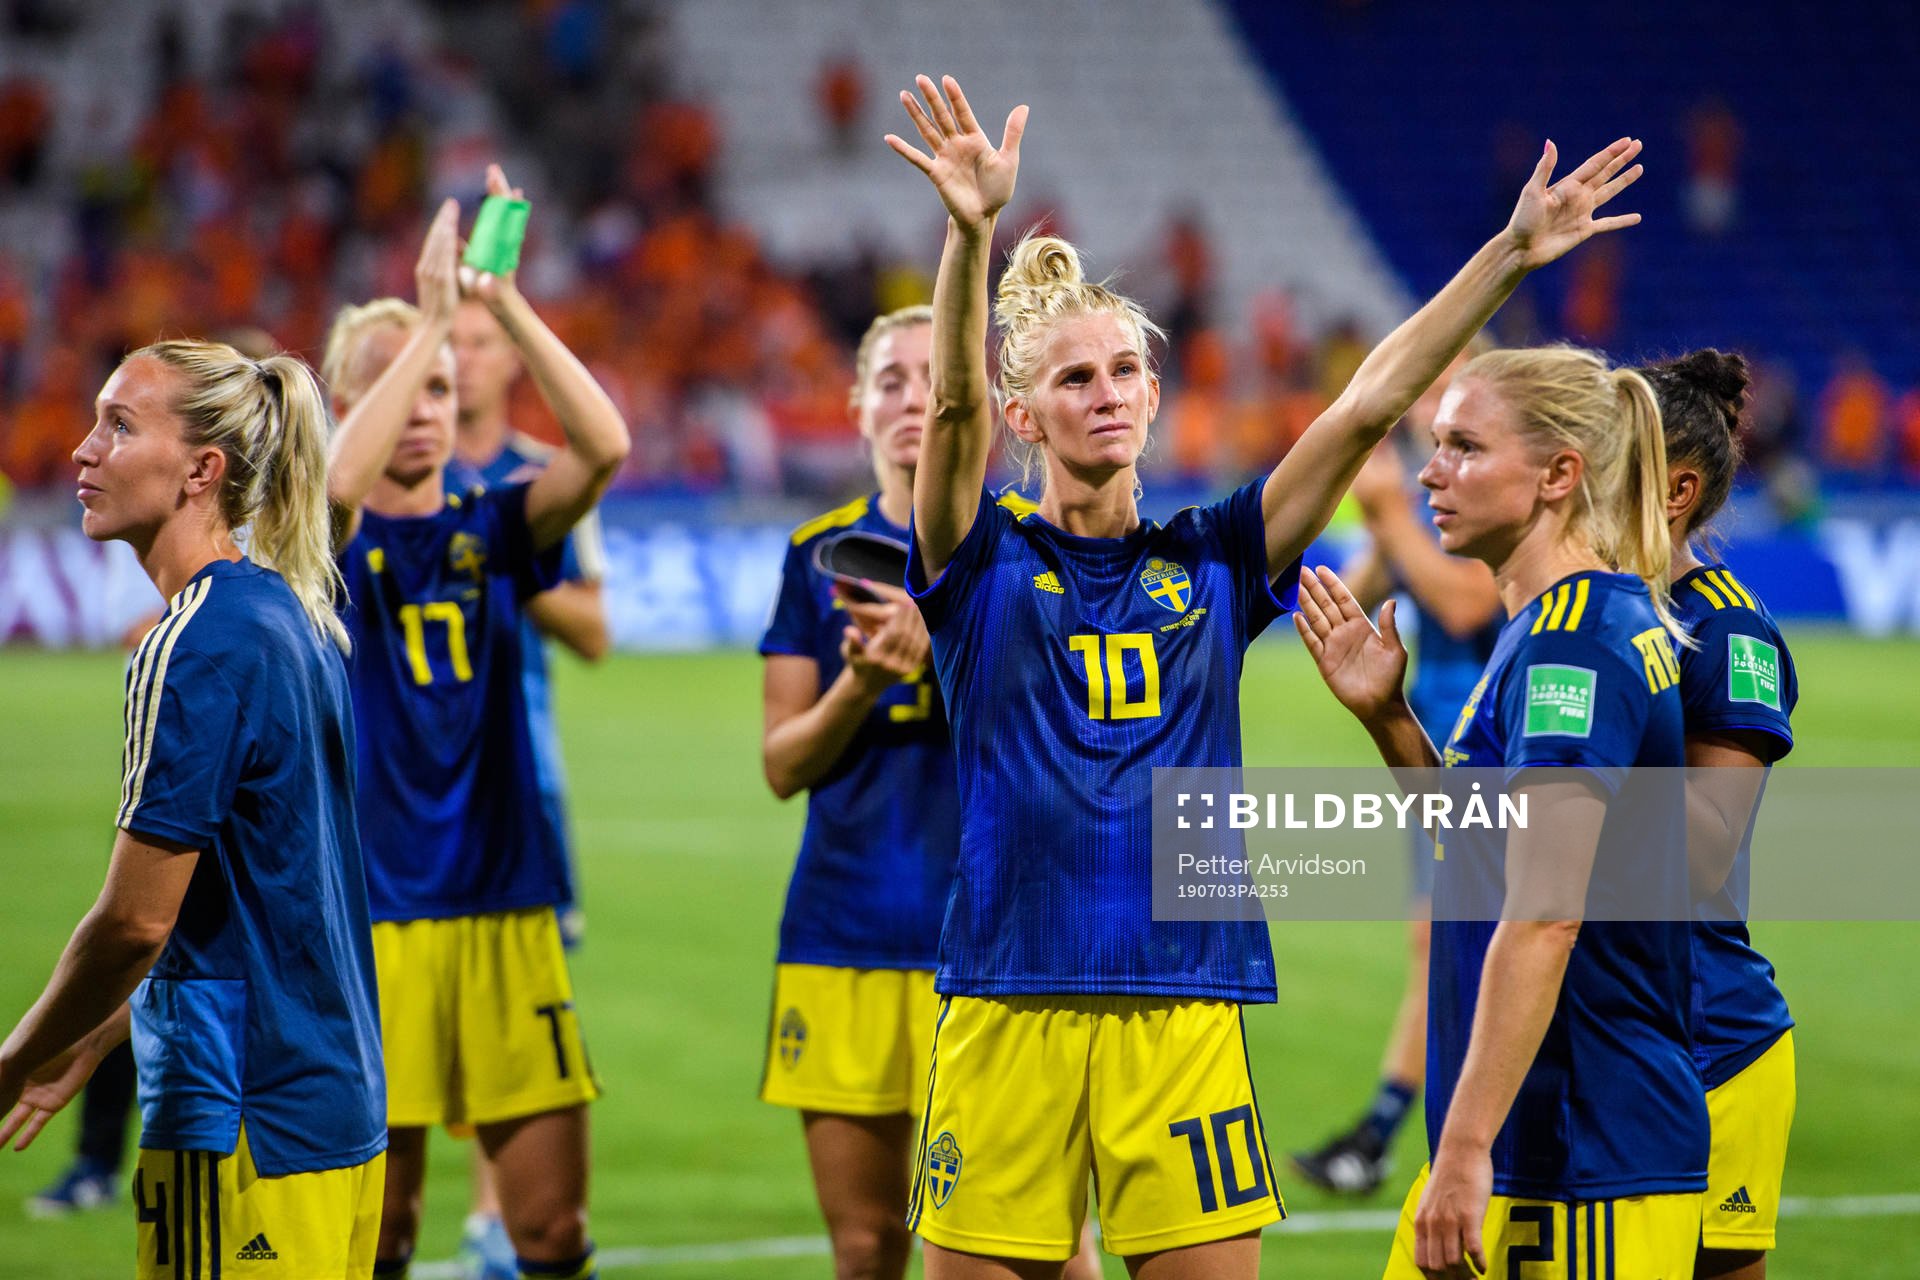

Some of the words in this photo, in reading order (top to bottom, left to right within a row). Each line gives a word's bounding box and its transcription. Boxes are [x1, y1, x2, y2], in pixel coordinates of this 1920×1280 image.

[1146, 569, 1179, 583] SVERIGE
[399, 601, 473, 685] 17
[1734, 653, 1775, 670] LIVING
[1734, 660, 1775, 677] FOOTBALL
[1068, 633, 1161, 720] 10
[1531, 684, 1588, 696] LIVING
[1760, 678, 1775, 693] FIFA
[1559, 706, 1585, 719] FIFA
[1168, 1103, 1270, 1214] 10
